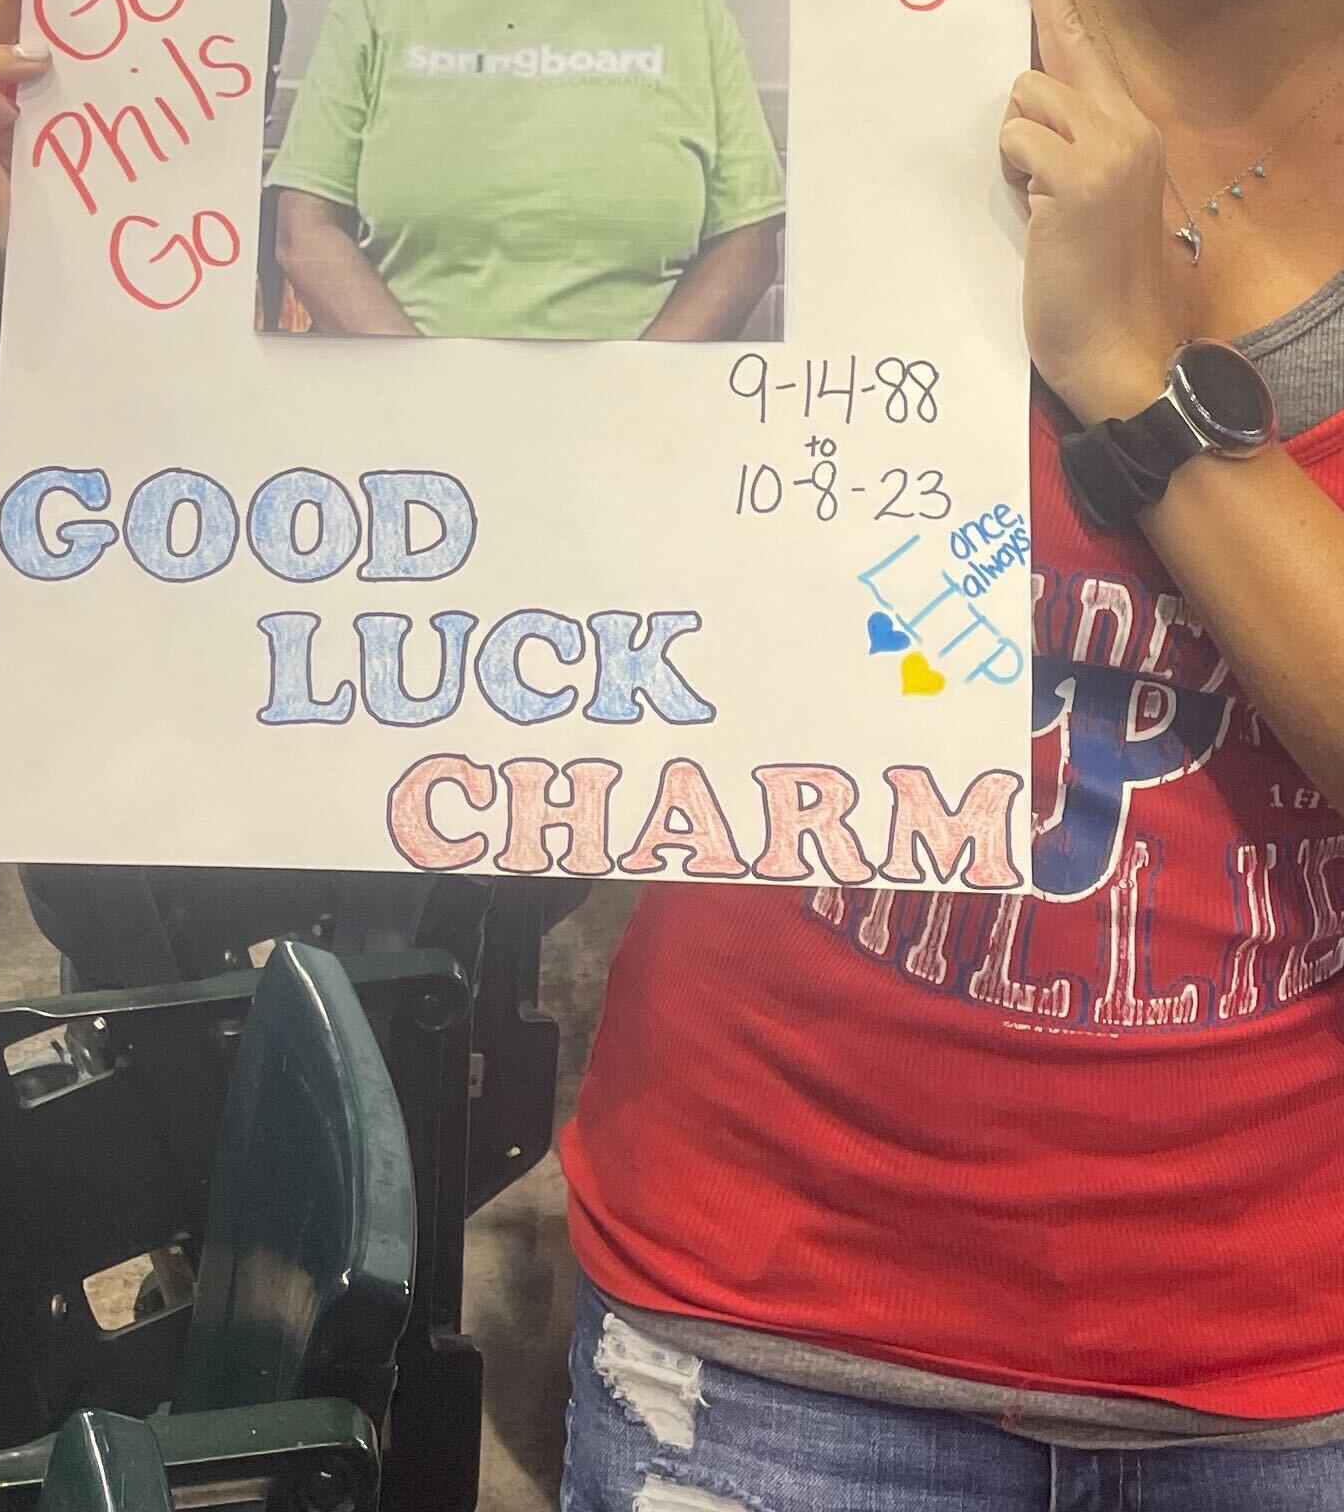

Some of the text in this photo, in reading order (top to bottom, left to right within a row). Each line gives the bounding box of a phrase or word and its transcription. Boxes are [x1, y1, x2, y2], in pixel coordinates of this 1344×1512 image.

[407, 43, 663, 78] Springboard
[31, 33, 253, 216] Phils
[729, 353, 940, 424] 9-14-88
[804, 435, 837, 458] to
[961, 526, 1033, 598] always
[256, 608, 717, 728] LUCK
[387, 752, 1026, 890] CHARM
